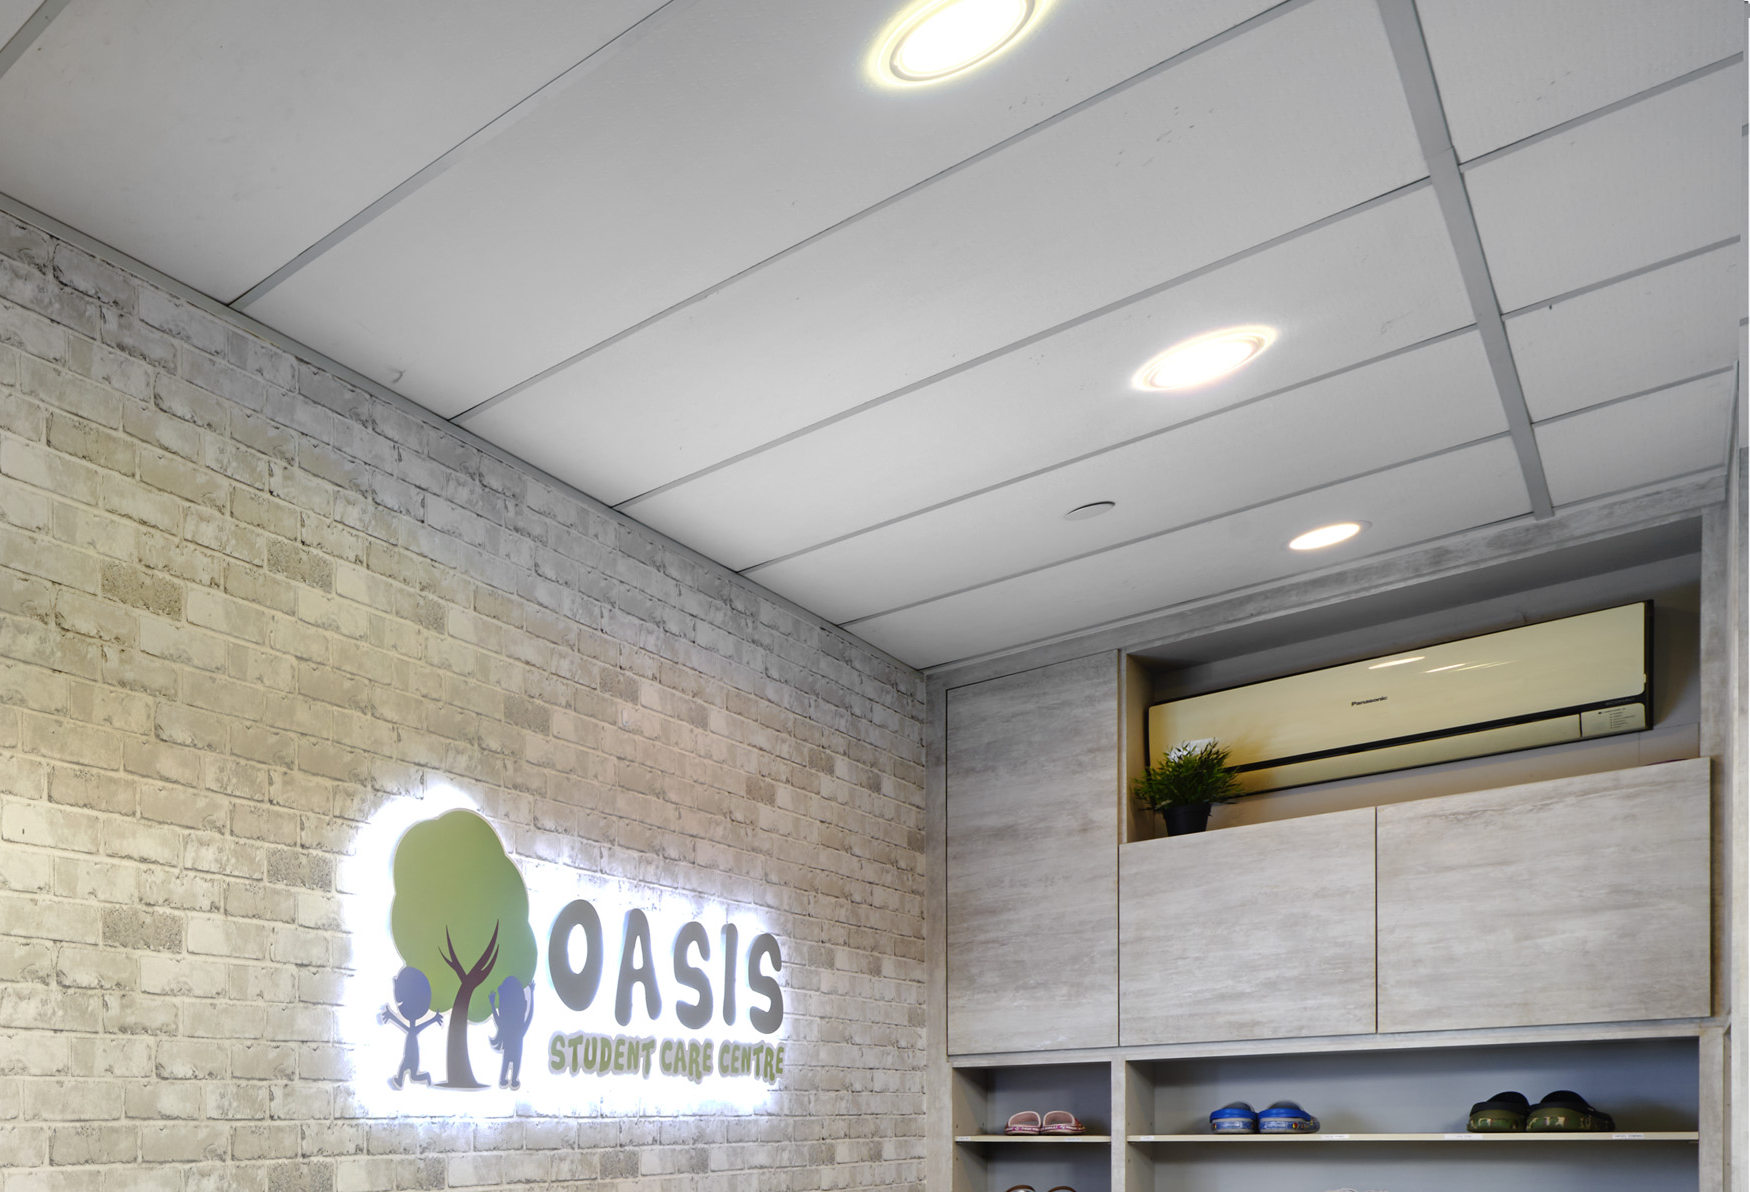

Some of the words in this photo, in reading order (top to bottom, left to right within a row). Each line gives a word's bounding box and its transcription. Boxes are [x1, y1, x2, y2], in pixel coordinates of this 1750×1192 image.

[1351, 696, 1388, 706] Panasonic
[548, 899, 784, 1034] OASIS
[550, 1034, 656, 1076] STUDENT
[661, 1039, 713, 1081] CARE
[719, 1040, 785, 1082] CENTRE
